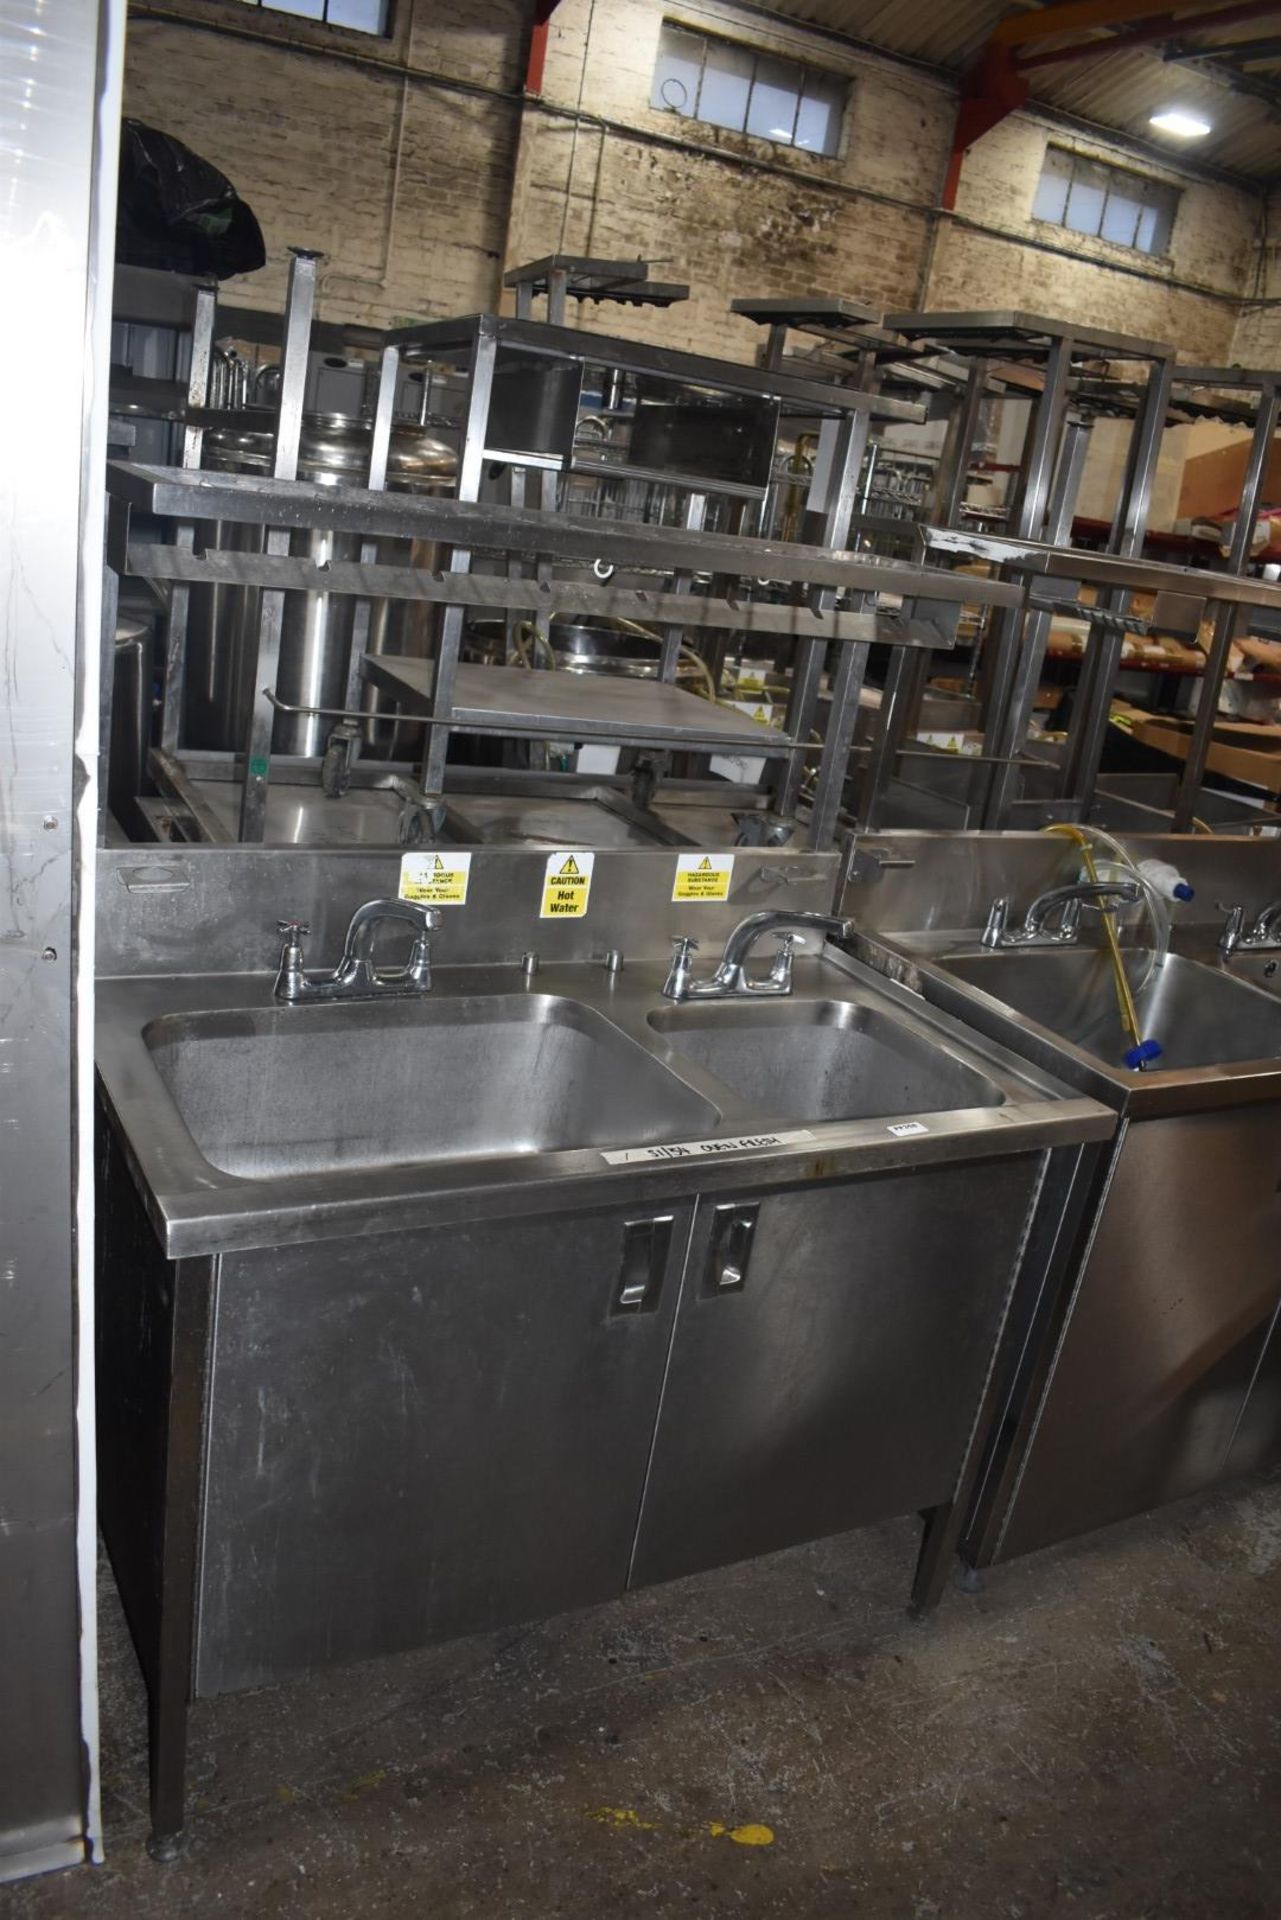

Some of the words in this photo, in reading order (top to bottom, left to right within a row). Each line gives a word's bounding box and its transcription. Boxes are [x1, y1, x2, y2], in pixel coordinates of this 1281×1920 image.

[551, 876, 586, 886] CAUTION
[557, 890, 575, 900] Hot
[550, 903, 579, 913] Water
